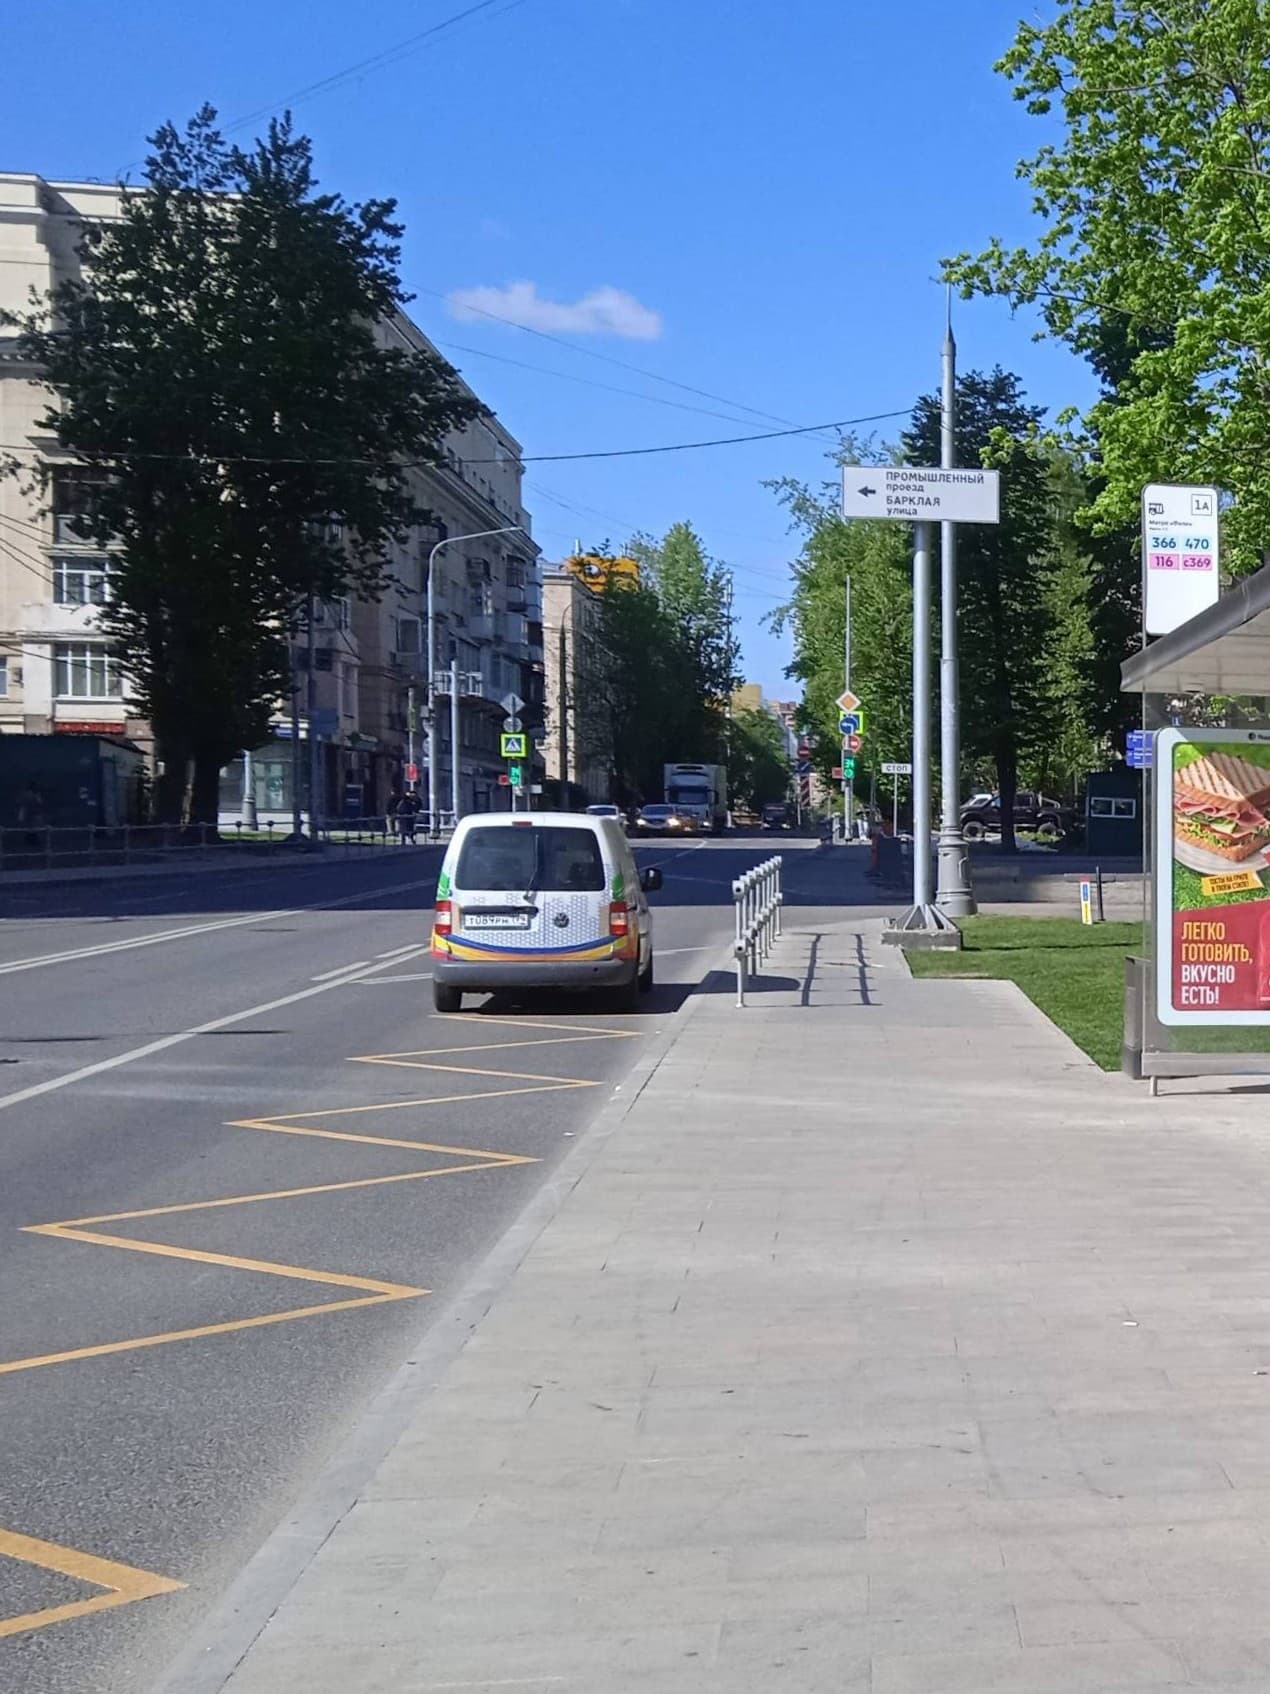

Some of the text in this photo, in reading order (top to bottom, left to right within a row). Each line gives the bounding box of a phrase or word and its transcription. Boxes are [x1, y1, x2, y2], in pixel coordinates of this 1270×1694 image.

[886, 471, 985, 484] ПРОМЫШЛЕННЫЙ
[886, 484, 924, 493] проезд
[886, 496, 941, 507] БАРКЛАЯ
[886, 507, 918, 516] улица
[1152, 536, 1209, 550] 366 470
[1155, 556, 1174, 568] 116
[1181, 921, 1225, 940] ЛЕГКО
[1181, 943, 1253, 965] ГОТОВИТЬ,
[1181, 964, 1236, 983] ВКУСНО
[1181, 985, 1219, 1005] ЕСТЬ!
